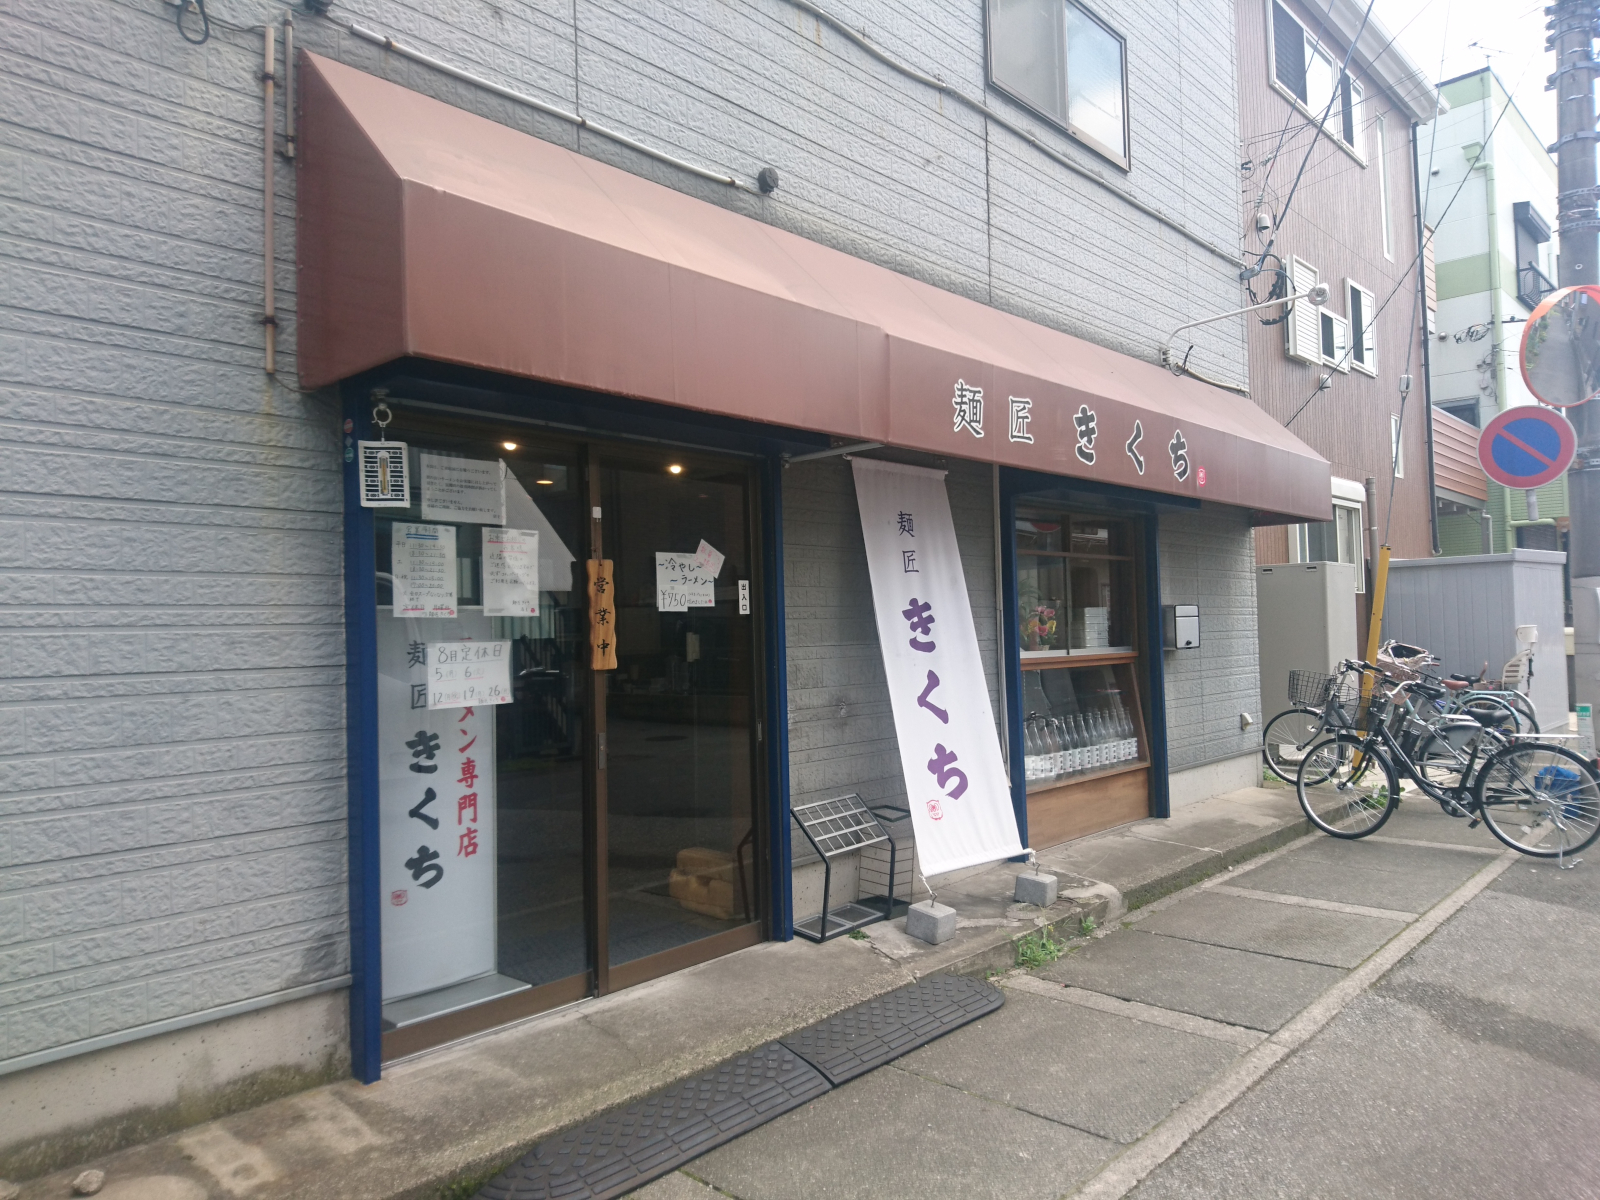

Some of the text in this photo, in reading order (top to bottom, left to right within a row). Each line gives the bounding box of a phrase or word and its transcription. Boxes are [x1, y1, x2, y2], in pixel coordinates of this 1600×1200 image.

[740, 583, 748, 611] 出入口
[593, 576, 612, 657] 営業中
[438, 644, 503, 664] 8月定休日
